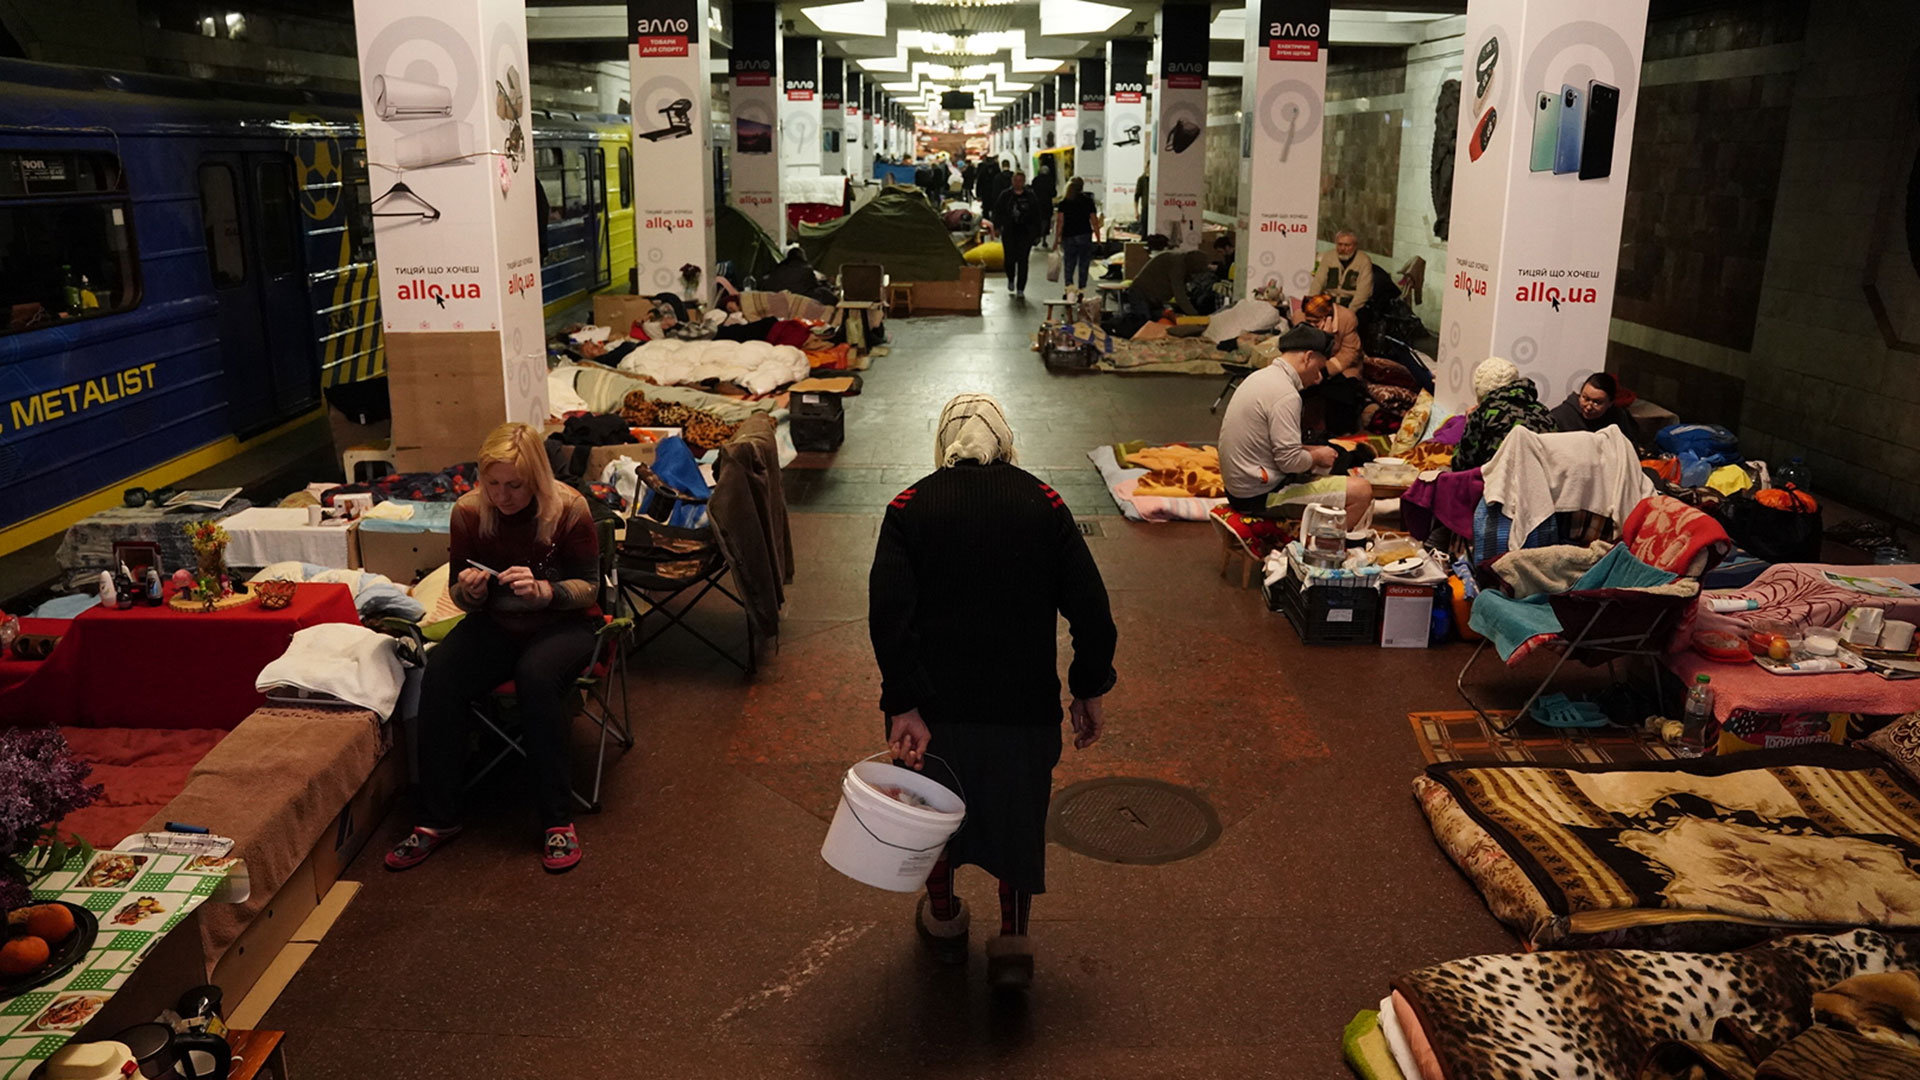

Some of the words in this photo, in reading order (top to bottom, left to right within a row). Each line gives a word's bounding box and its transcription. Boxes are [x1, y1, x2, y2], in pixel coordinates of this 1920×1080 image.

[645, 216, 693, 228] allo.ua
[1260, 220, 1308, 233] allo.ua
[395, 266, 426, 275] ТИЦЯЙ
[427, 266, 444, 275] ЩО
[446, 266, 480, 274] ХОЧЕШ
[1518, 268, 1547, 277] ТИЦЯЙ
[1549, 270, 1565, 278] ЩО
[1567, 269, 1600, 279] ХОЧЕШ
[397, 279, 481, 300] allo.ua
[1454, 271, 1487, 296] allo.ua
[1515, 282, 1597, 304] allo.ua
[9, 362, 157, 431] METALIST
